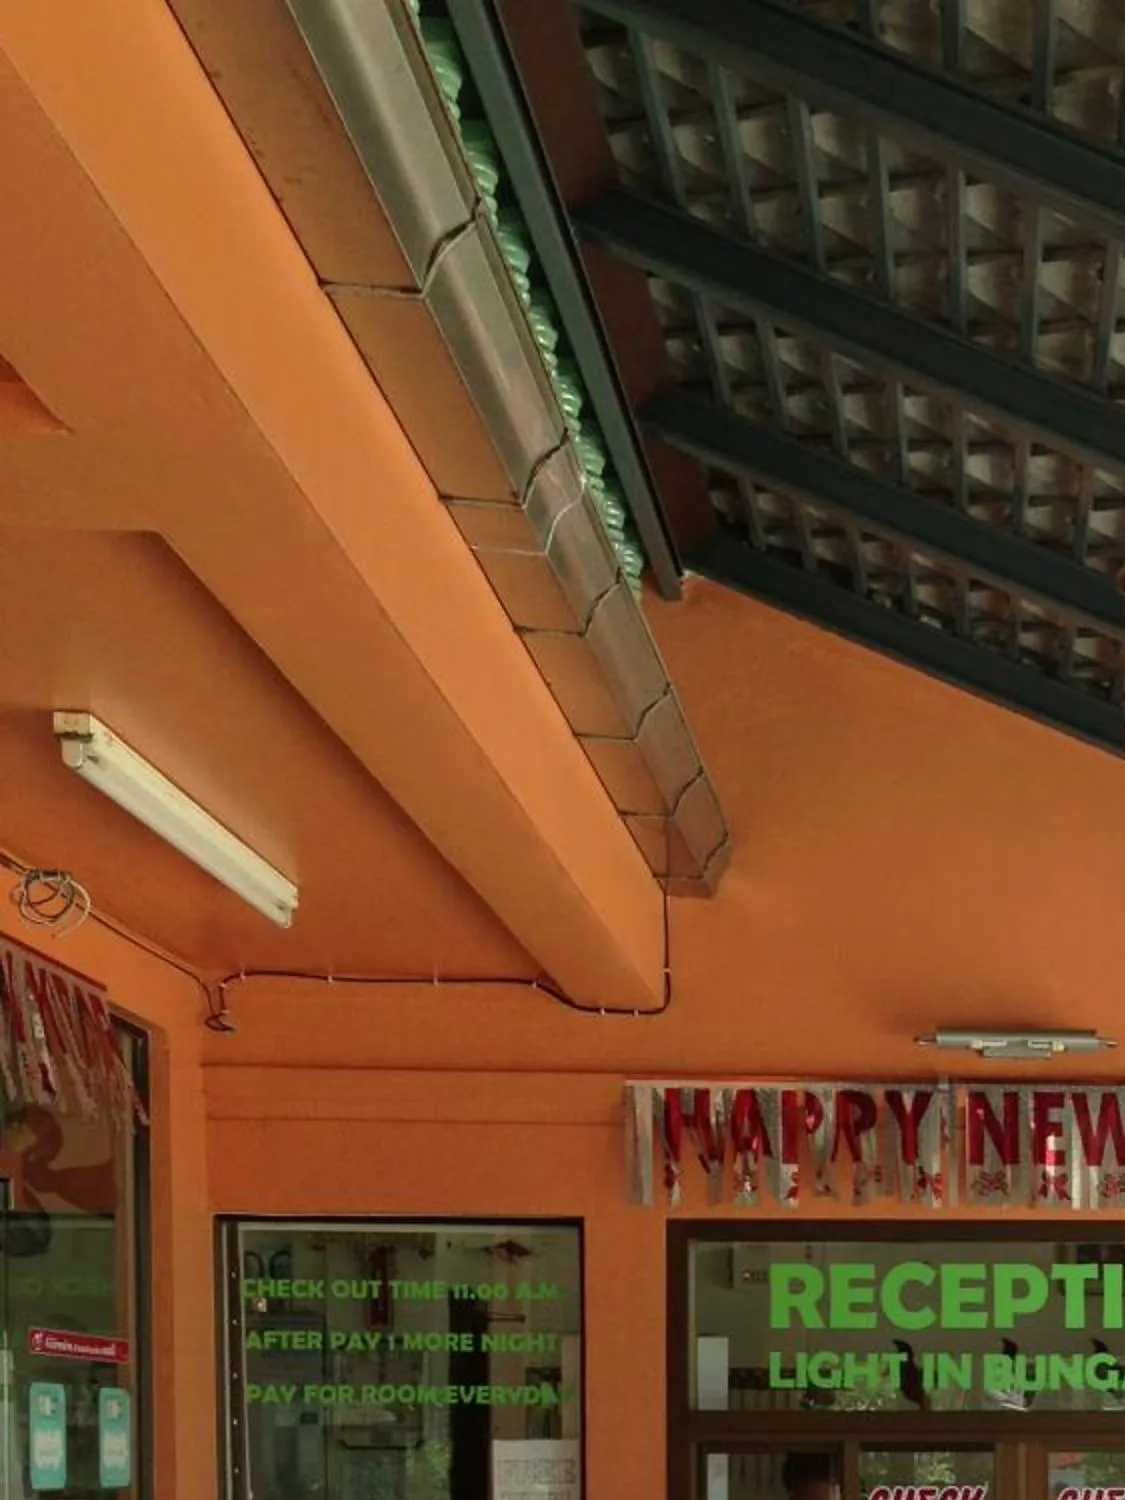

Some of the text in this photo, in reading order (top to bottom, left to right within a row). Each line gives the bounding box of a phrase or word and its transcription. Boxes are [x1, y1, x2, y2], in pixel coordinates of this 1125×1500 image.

[663, 1087, 934, 1168] HAPPY
[241, 1279, 325, 1299] CHECK
[330, 1280, 382, 1299] OUT
[391, 1280, 446, 1299] TIME
[246, 1330, 323, 1351] AFTER
[330, 1331, 381, 1351] PAY
[403, 1332, 474, 1352] MORE
[480, 1333, 560, 1353] NIGHT
[768, 1351, 908, 1391] LIGHT
[921, 1352, 974, 1391] IN
[246, 1384, 298, 1405] PAY
[303, 1385, 352, 1405] FOR
[361, 1385, 440, 1406] ROOM
